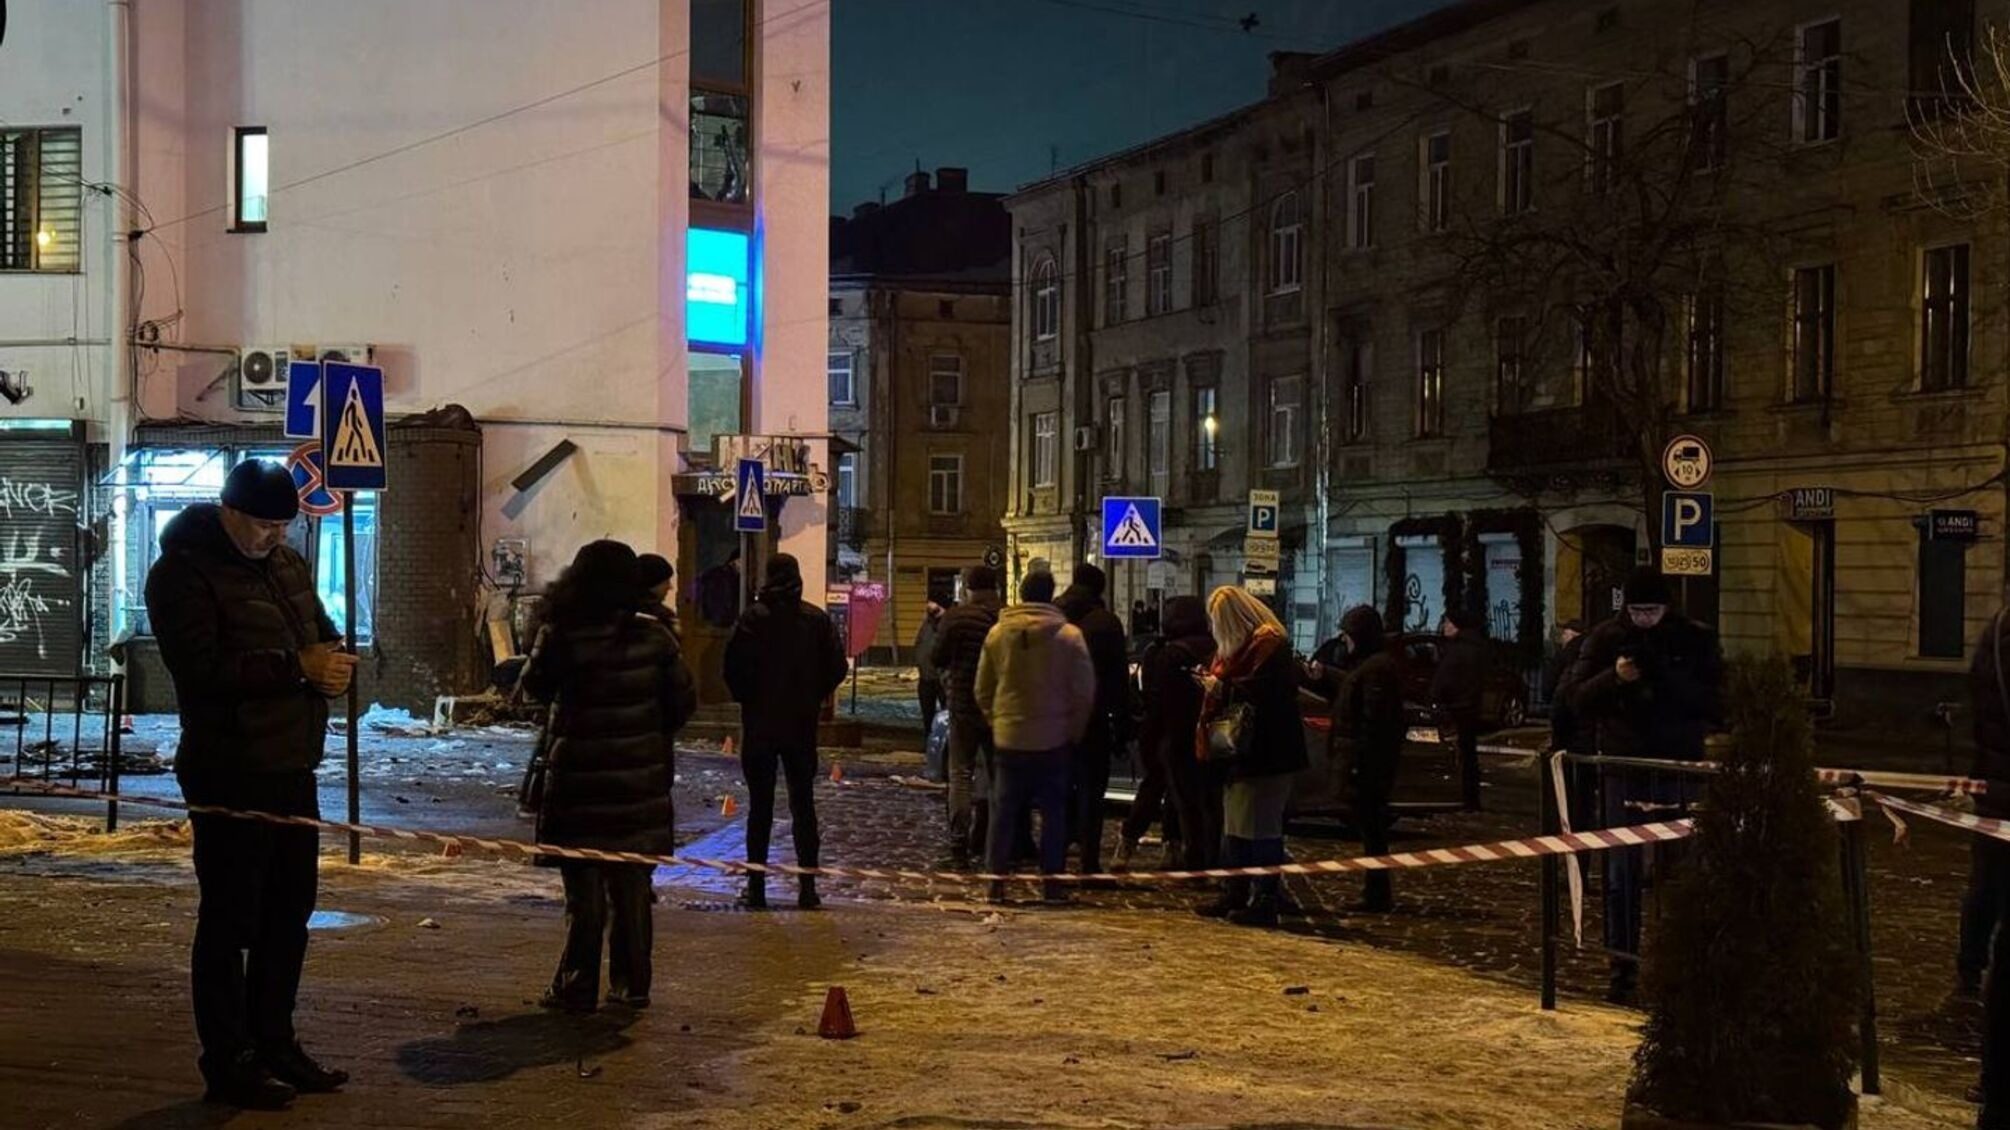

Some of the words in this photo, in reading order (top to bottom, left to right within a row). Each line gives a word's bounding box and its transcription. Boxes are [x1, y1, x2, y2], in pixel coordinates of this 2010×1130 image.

[1795, 489, 1830, 506] ANDI
[1257, 508, 1270, 528] P
[1674, 498, 1702, 541] P
[1692, 556, 1706, 568] 50
